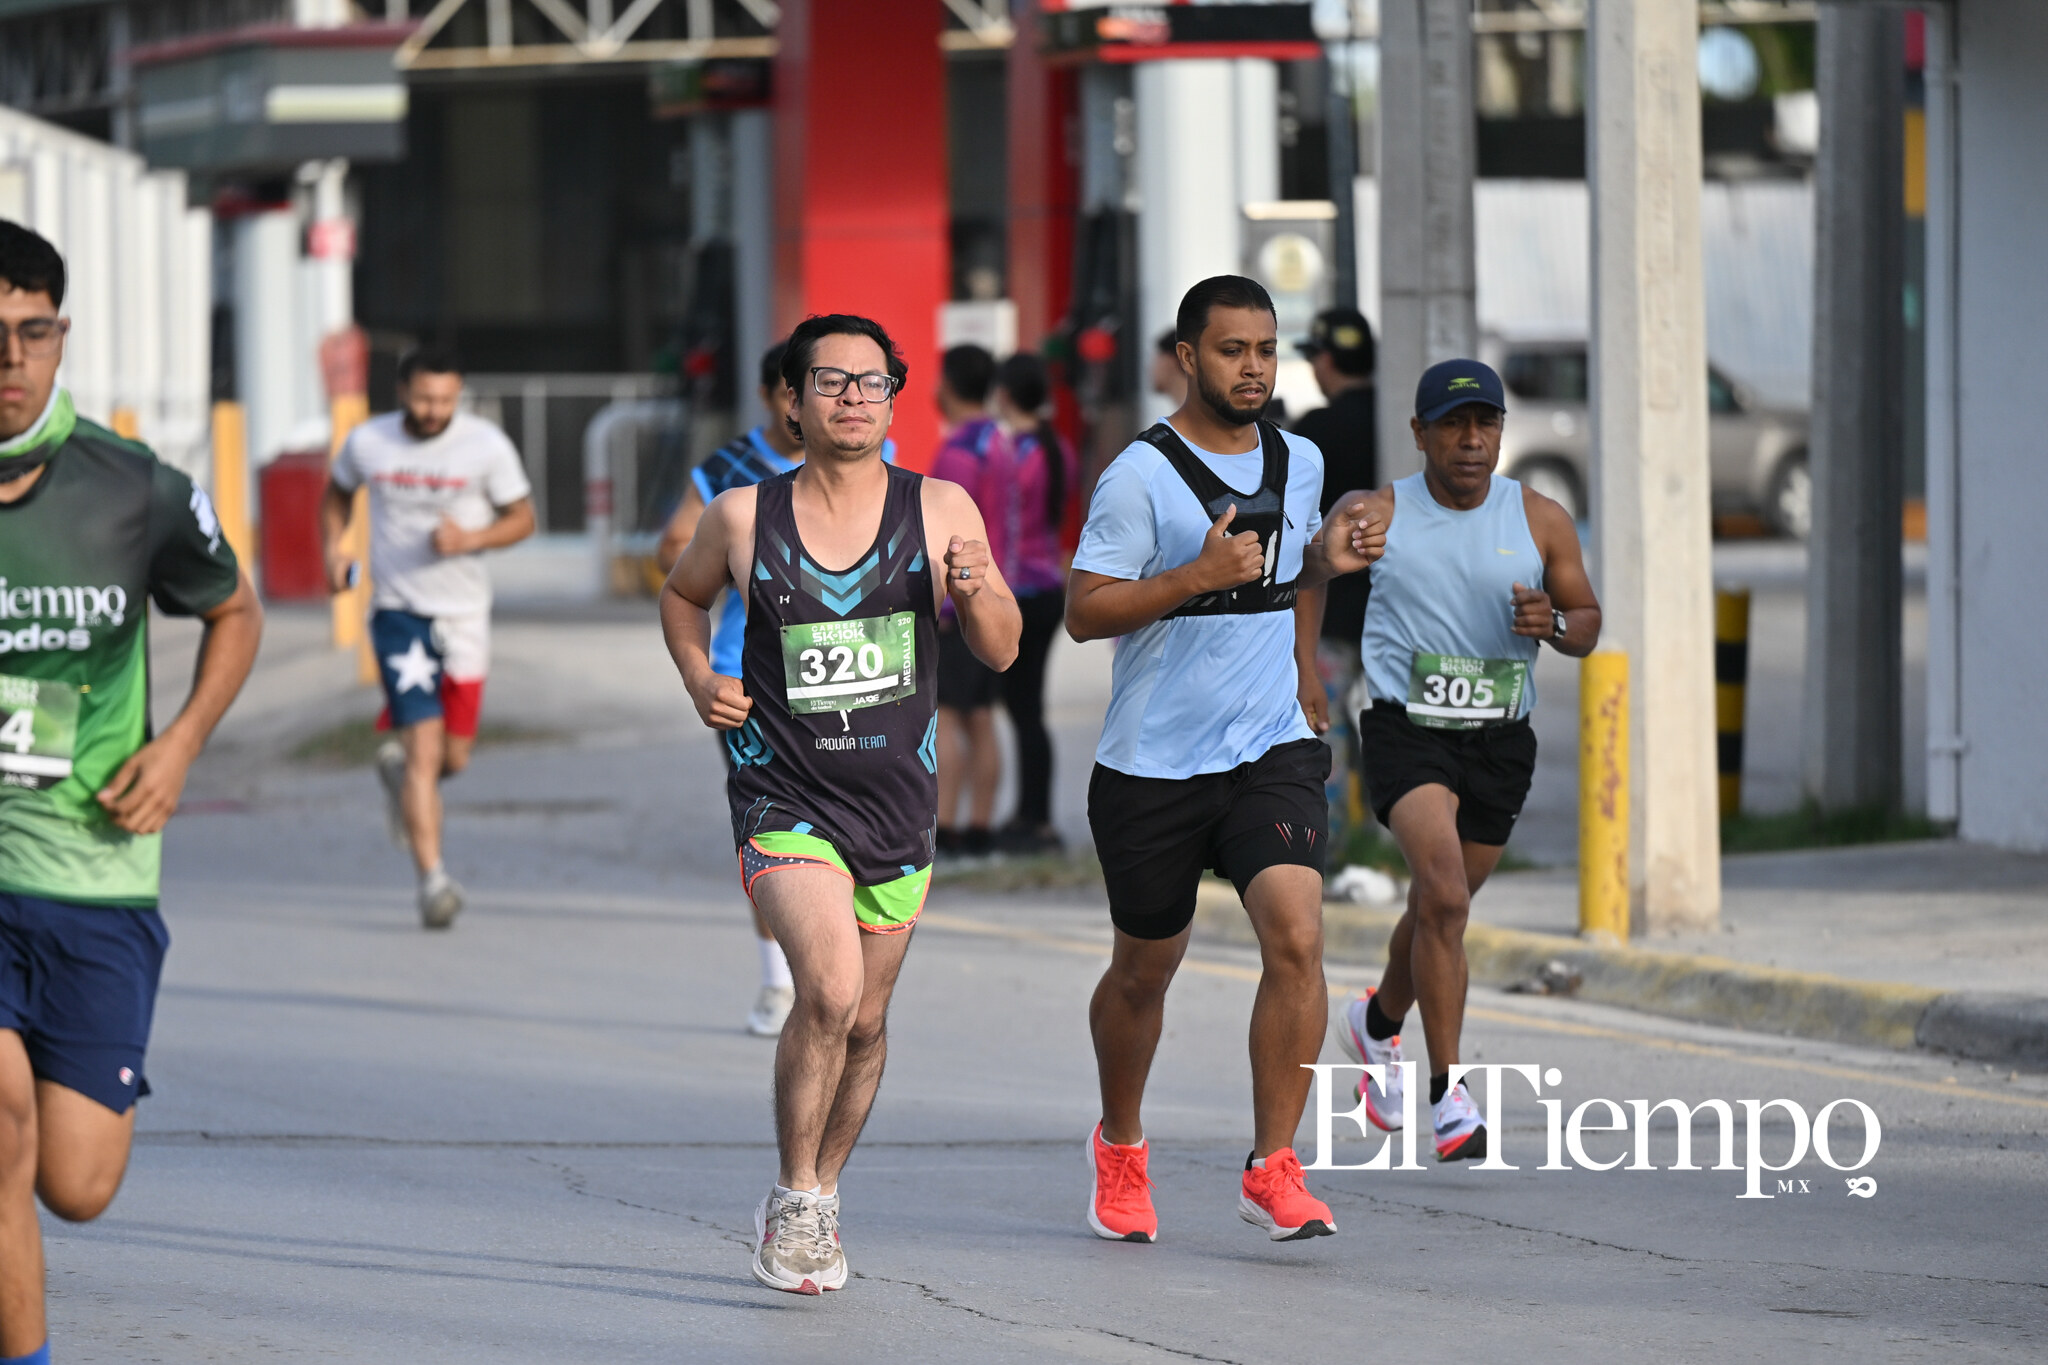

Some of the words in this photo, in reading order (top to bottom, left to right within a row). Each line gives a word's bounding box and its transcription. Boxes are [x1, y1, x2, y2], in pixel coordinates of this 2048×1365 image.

[0, 577, 126, 626] iempo
[0, 623, 91, 652] odos
[811, 621, 864, 632] CARRERA
[898, 617, 911, 626] 320
[800, 643, 883, 685] 320
[902, 630, 911, 687] MEDALLA
[1423, 674, 1494, 708] 305
[1507, 673, 1522, 719] MEDALLA
[0, 709, 35, 754] 4
[816, 735, 856, 751] ORDUÑA
[858, 734, 887, 750] TEAM
